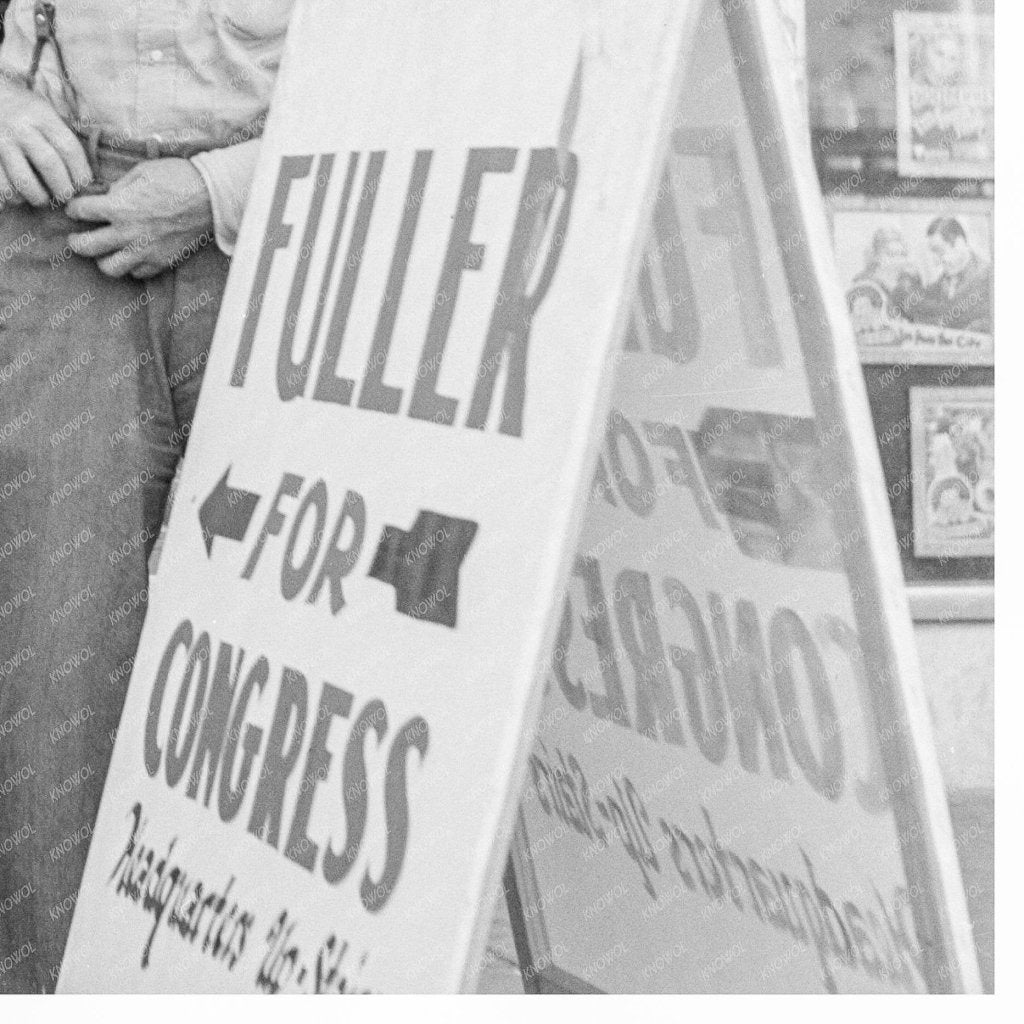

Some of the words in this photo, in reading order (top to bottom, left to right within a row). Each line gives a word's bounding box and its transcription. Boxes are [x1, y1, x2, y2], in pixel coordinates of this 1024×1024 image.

[230, 146, 580, 438] FULLER
[240, 471, 369, 616] FOR
[142, 617, 431, 914] CONGRESS
[107, 801, 255, 971] Headquarters
